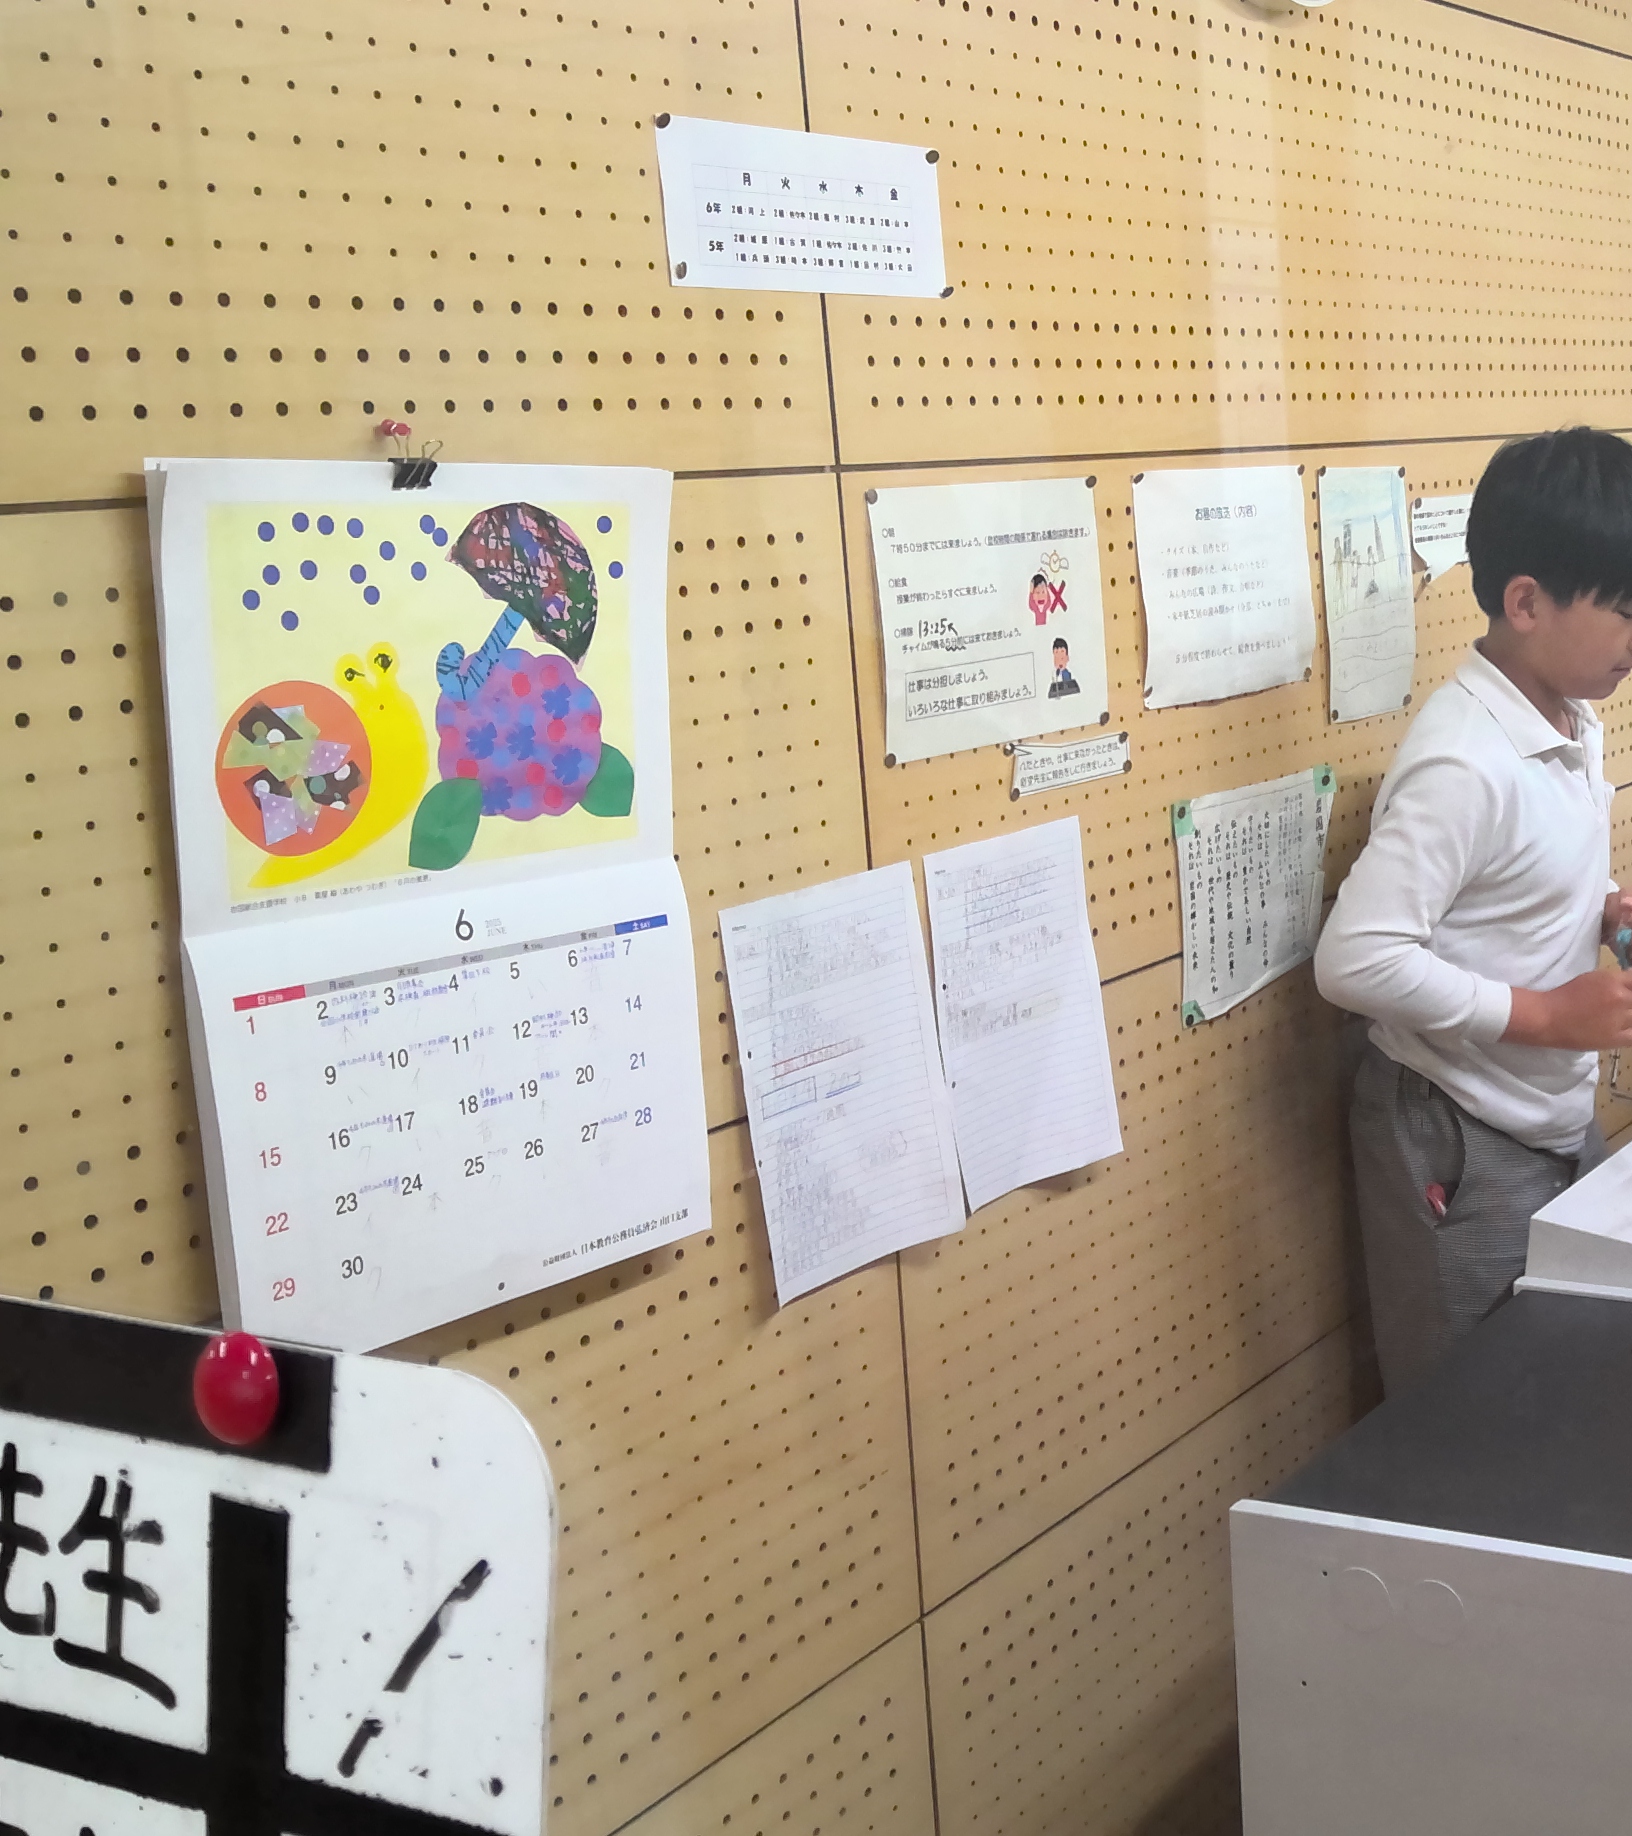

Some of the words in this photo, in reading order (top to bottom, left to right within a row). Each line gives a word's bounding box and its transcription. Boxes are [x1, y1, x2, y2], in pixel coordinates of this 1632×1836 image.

[743, 172, 751, 187] 月
[781, 176, 790, 190] 火
[819, 180, 828, 194] 水
[855, 184, 863, 197] 木
[890, 188, 898, 200] 金
[706, 202, 721, 213] 6年
[709, 240, 724, 252] 5年
[908, 669, 989, 693] 仕事は分担しましょう。
[908, 684, 1032, 718] いろいろな仕事に取り組みましょう。
[455, 908, 474, 941] 6
[246, 1015, 255, 1035] 1
[316, 1000, 329, 1020] 2
[383, 986, 396, 1006] 3
[449, 974, 459, 992] 4
[509, 961, 520, 980] 5
[567, 949, 578, 967] 6
[622, 938, 632, 956] 7
[254, 1081, 267, 1102] 8
[324, 1065, 337, 1085] 9
[388, 1048, 409, 1070] 10
[452, 1034, 470, 1055] 11
[512, 1020, 532, 1040] 12
[569, 1006, 589, 1026] 13
[624, 994, 642, 1013] 14
[259, 1146, 282, 1169] 15
[328, 1128, 351, 1150] 16
[395, 1111, 415, 1132] 17
[458, 1095, 479, 1116] 18
[519, 1079, 538, 1100] 19
[575, 1064, 595, 1085] 20
[629, 1051, 646, 1071] 21
[265, 1212, 290, 1237] 22
[335, 1192, 358, 1216] 23
[401, 1173, 423, 1196] 24
[464, 1155, 485, 1178] 25
[524, 1138, 544, 1160] 26
[580, 1122, 599, 1143] 27
[634, 1106, 652, 1127] 28
[272, 1277, 296, 1302] 29
[341, 1255, 364, 1279] 30
